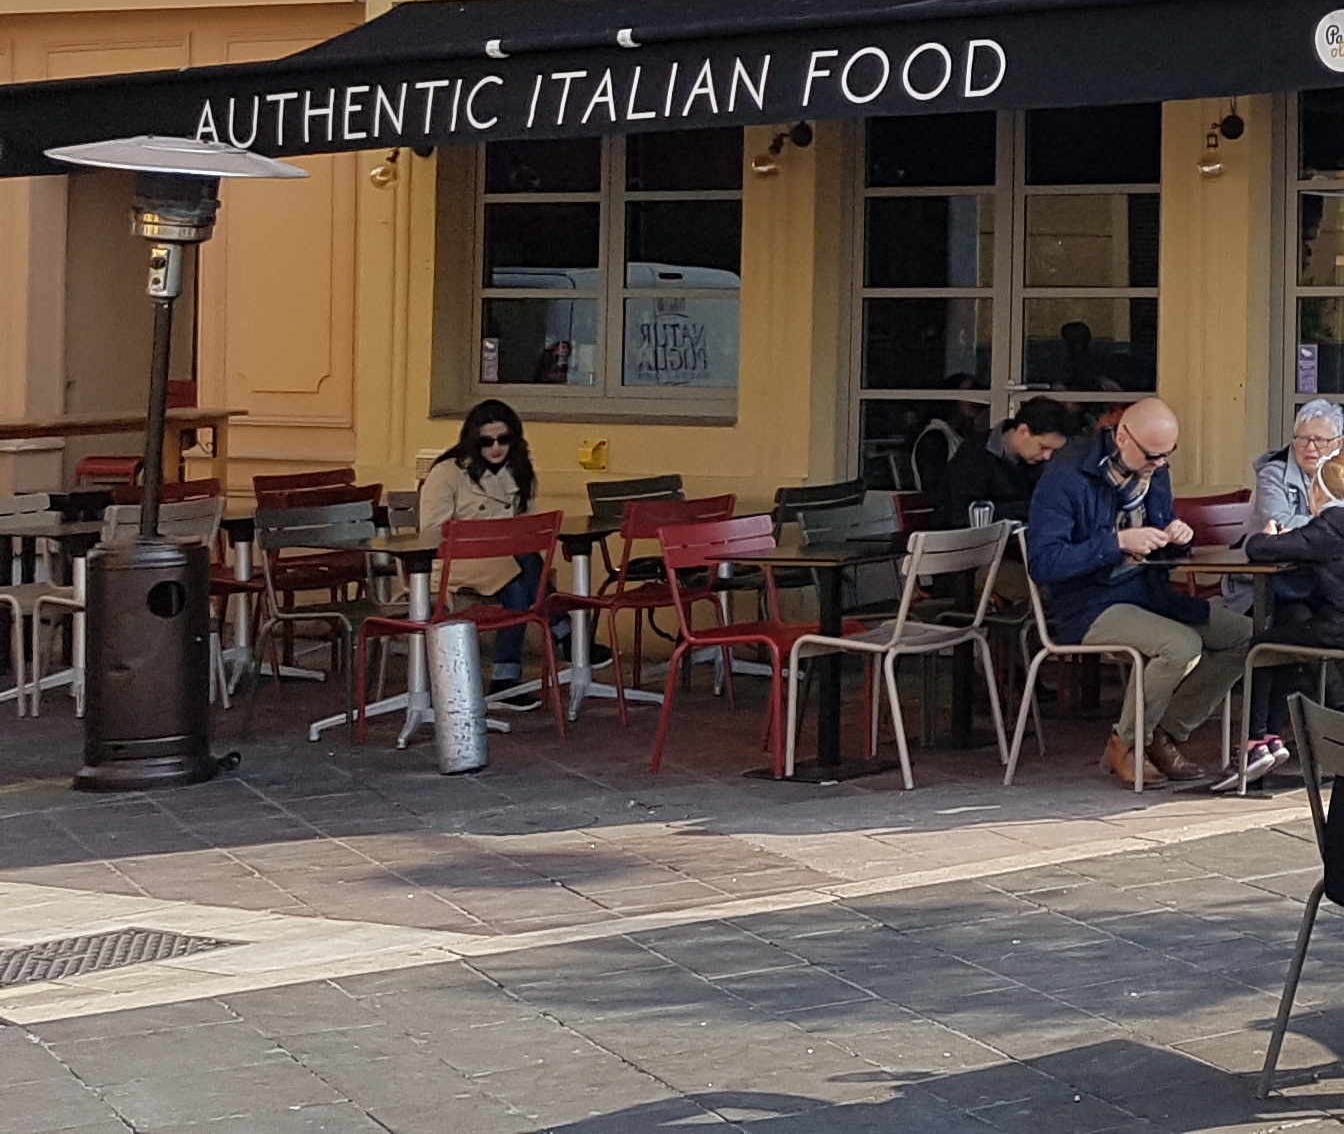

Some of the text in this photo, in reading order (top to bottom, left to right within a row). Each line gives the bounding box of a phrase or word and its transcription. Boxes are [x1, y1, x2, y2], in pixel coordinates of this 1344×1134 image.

[196, 38, 1007, 151] AUTHENTIC ITALIAN FOOD
